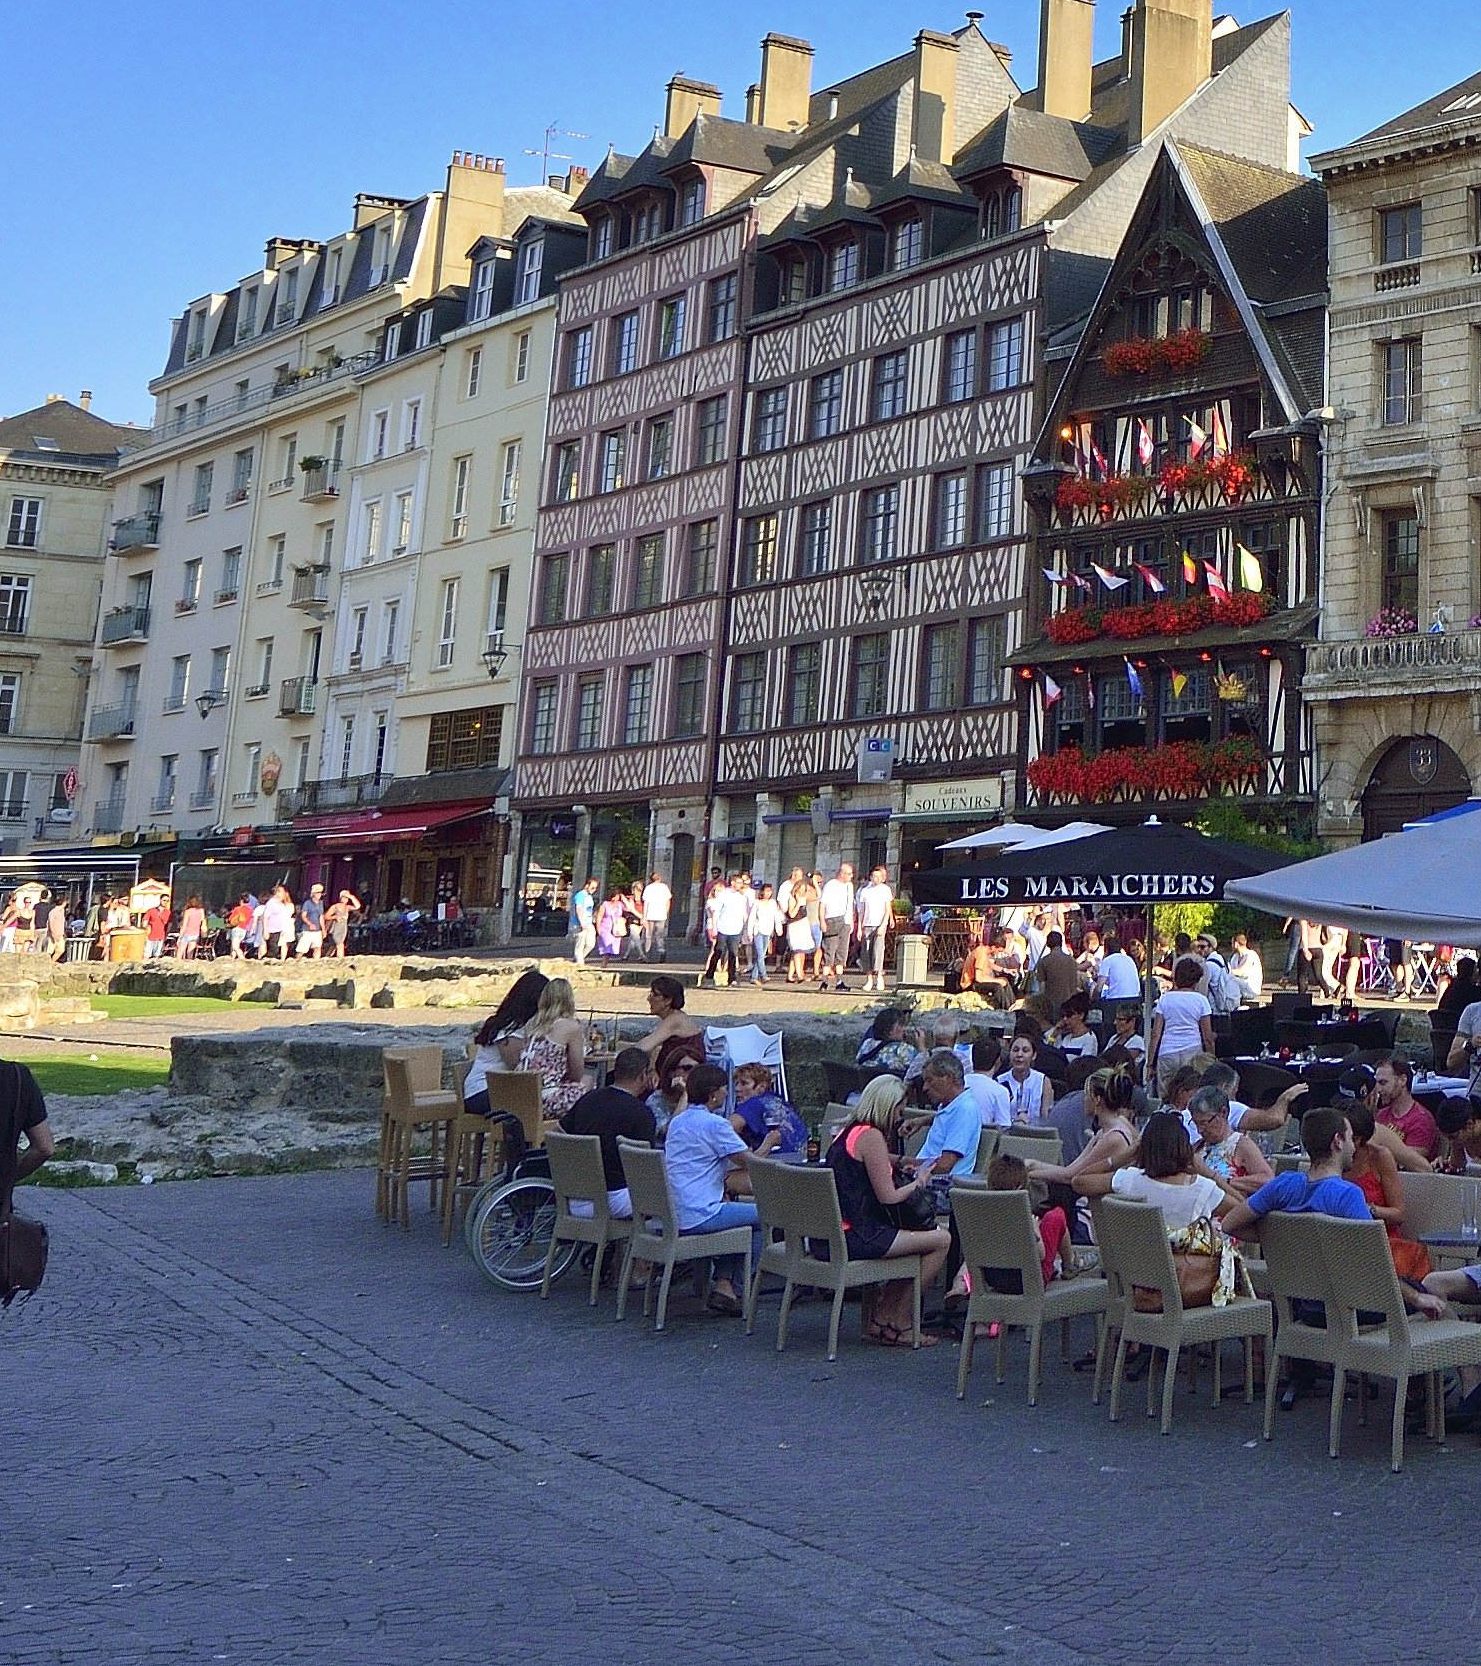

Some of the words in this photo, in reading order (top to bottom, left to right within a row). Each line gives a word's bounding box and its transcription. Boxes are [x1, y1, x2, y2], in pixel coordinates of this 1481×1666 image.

[938, 785, 967, 795] Cadeaux
[914, 794, 992, 812] SOUVENIRS
[960, 877, 1009, 899] LES
[1024, 874, 1215, 897] MARAICHERS
